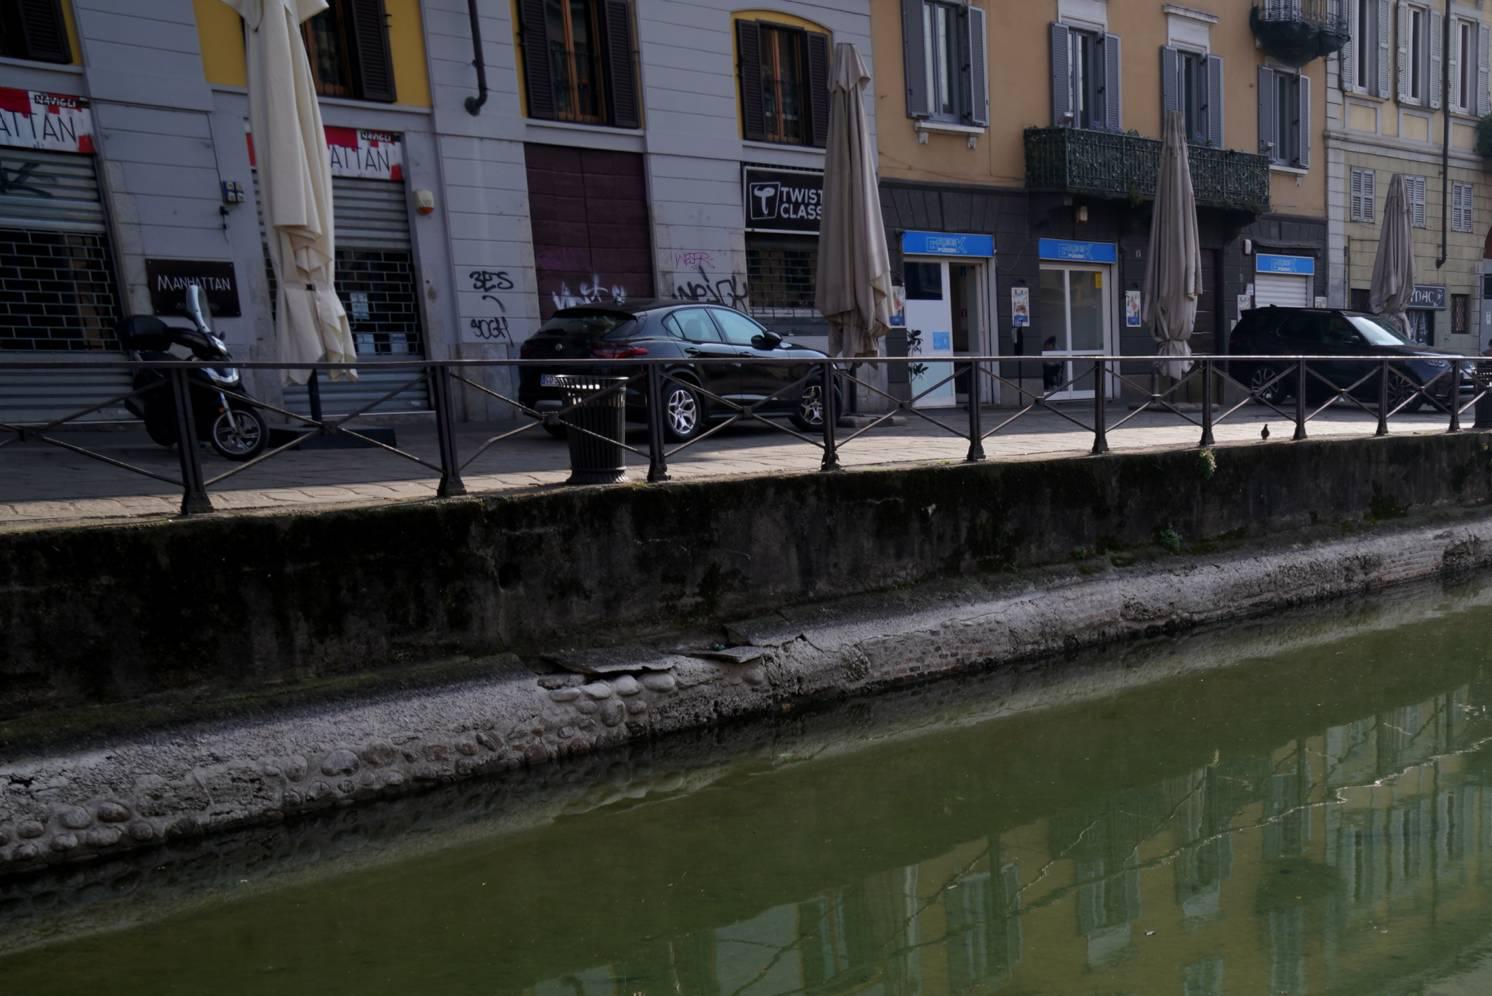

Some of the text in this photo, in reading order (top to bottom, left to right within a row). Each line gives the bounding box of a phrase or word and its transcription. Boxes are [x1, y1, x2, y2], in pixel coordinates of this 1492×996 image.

[35, 95, 77, 108] NAVIGLI
[780, 187, 824, 204] TWIST
[780, 203, 822, 220] CLASS
[158, 275, 231, 292] MANHATTAN
